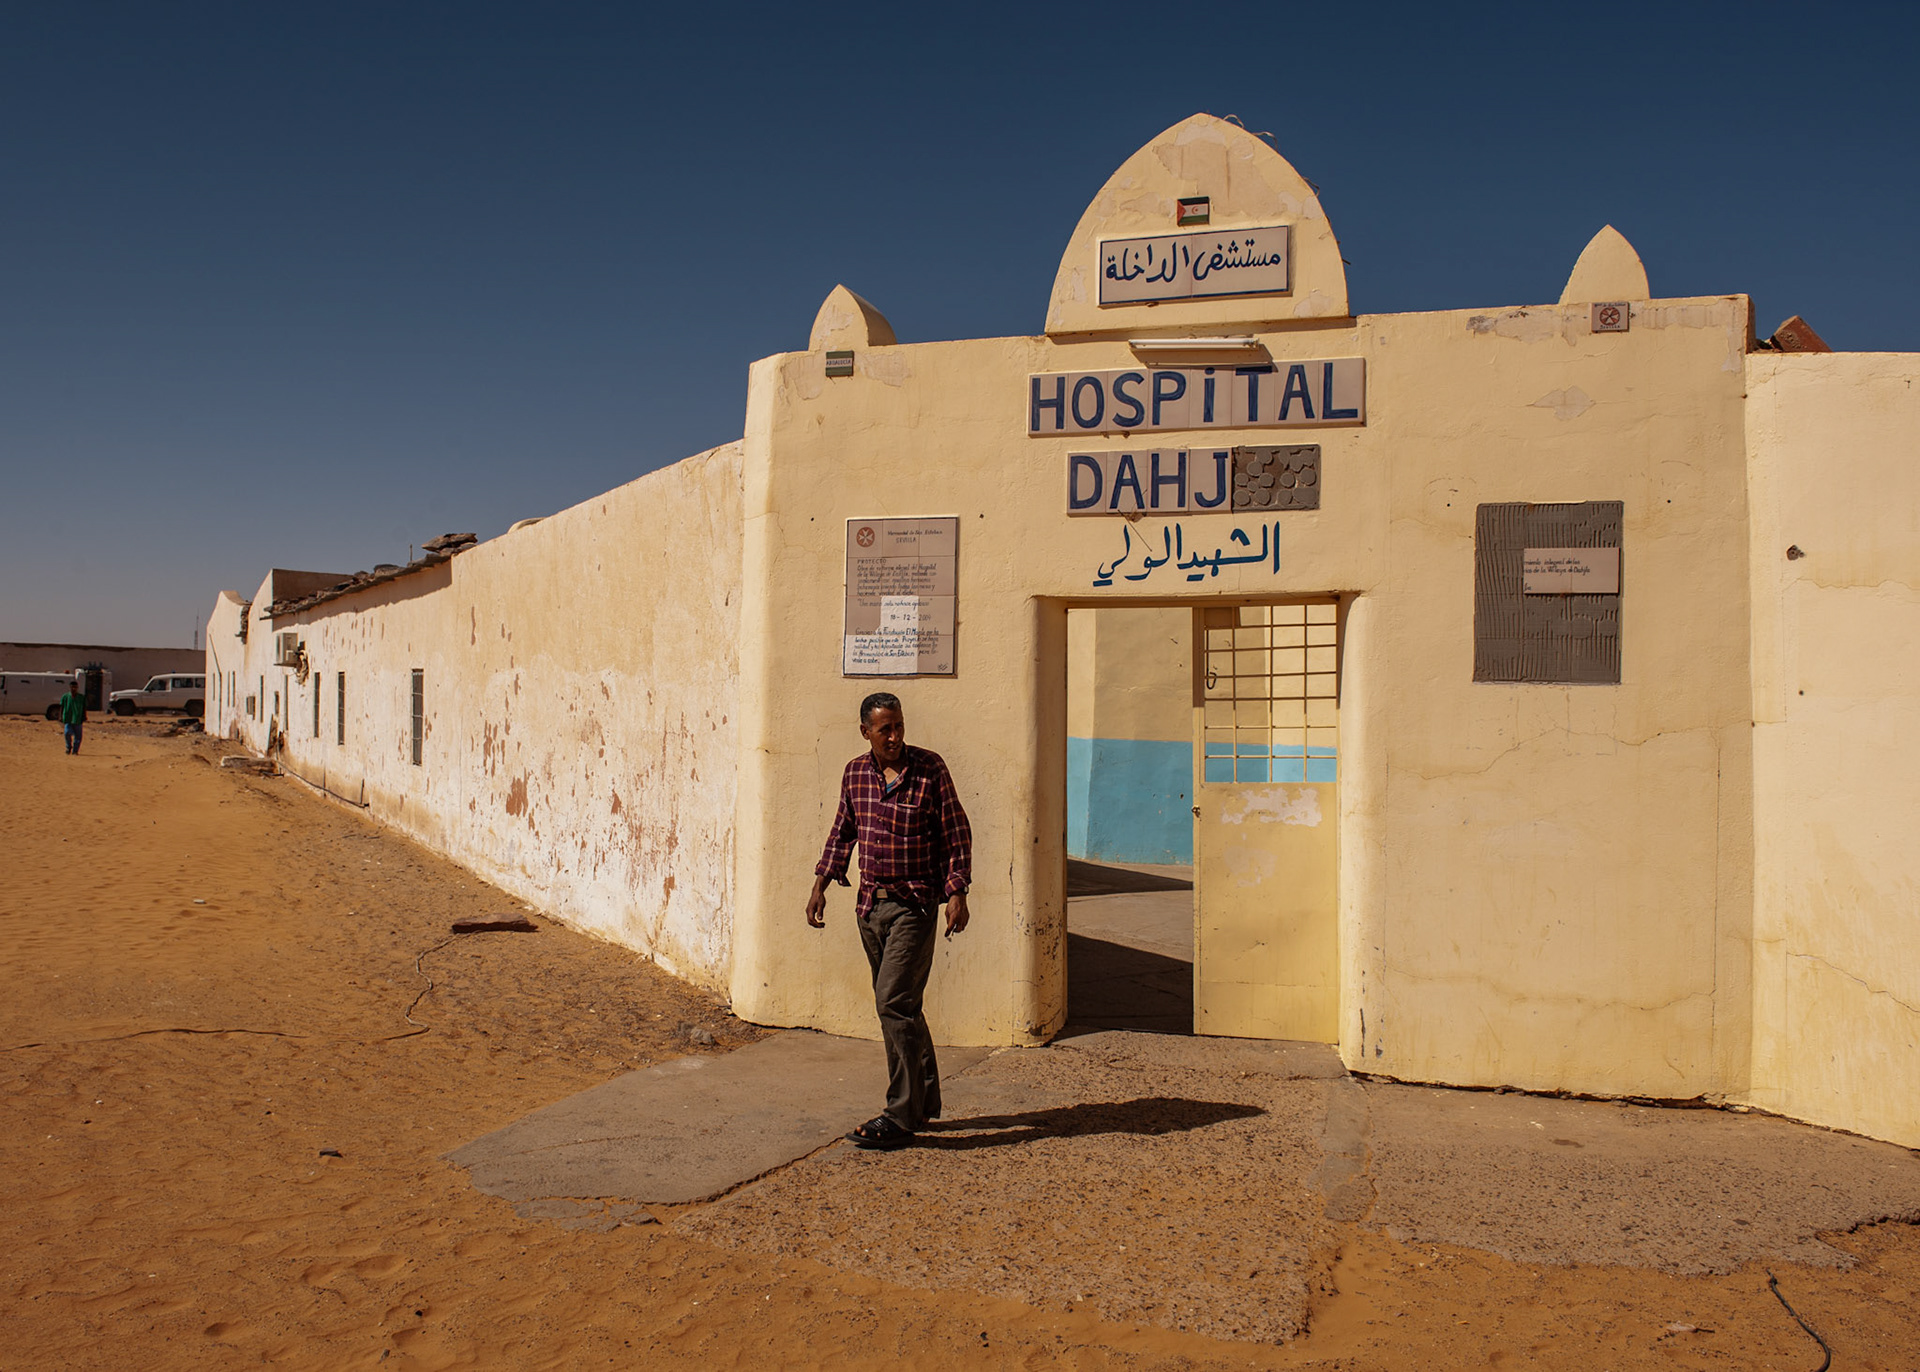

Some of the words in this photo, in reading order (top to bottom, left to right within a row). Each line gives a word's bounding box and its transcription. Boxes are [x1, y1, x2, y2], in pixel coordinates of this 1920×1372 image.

[1070, 451, 1228, 510] DAHJ
[1092, 522, 1182, 587] الولي
[1177, 520, 1280, 582] الشهيد
